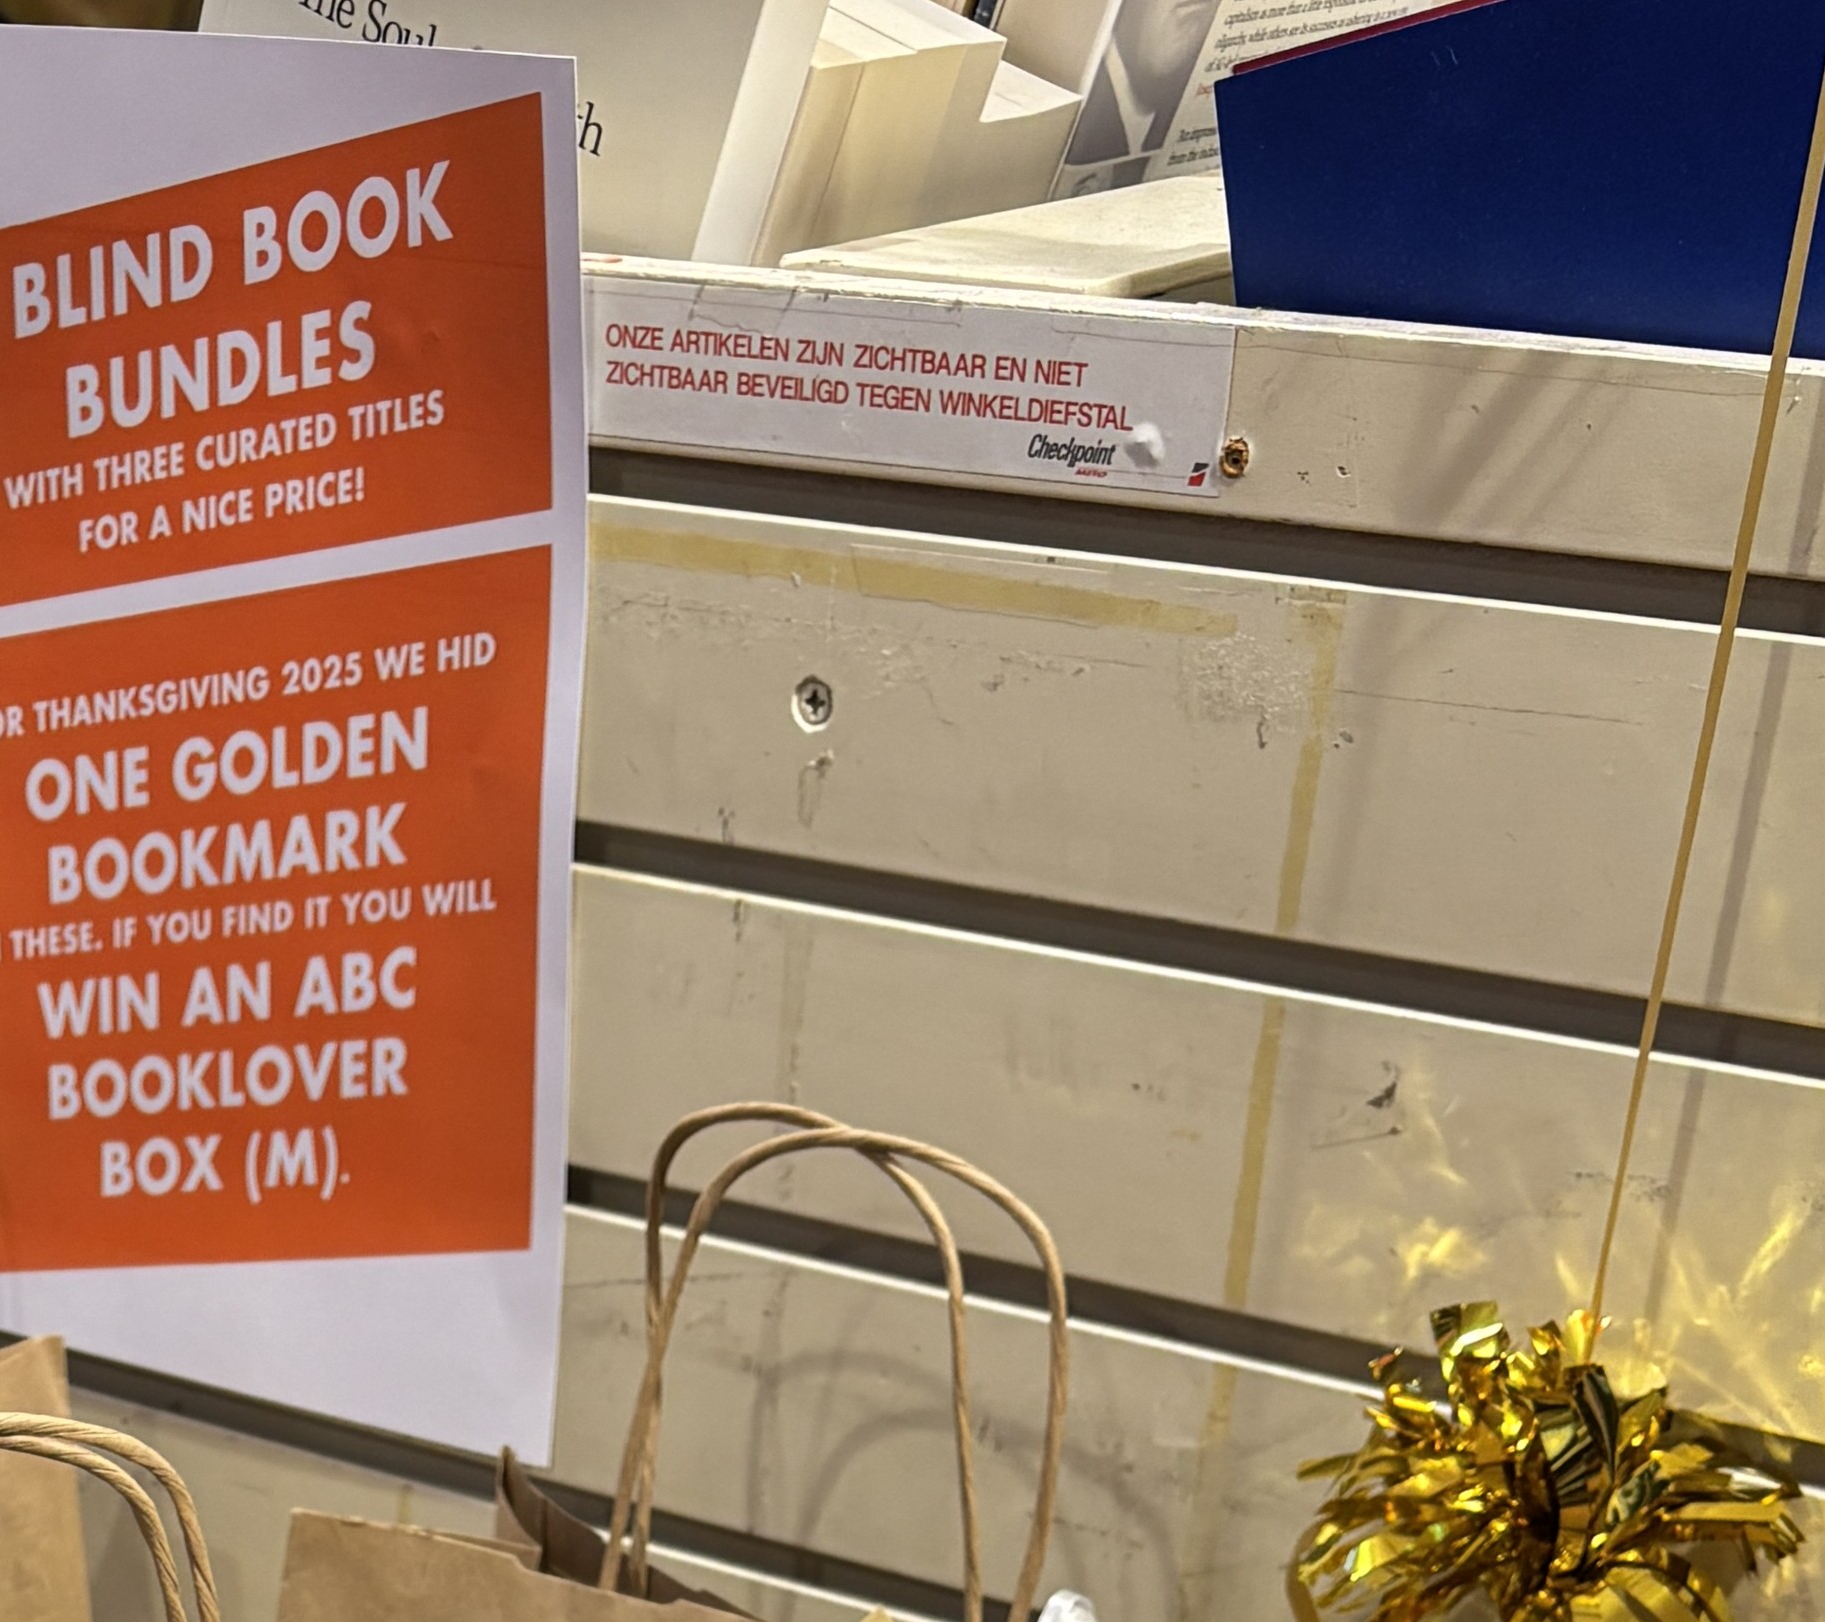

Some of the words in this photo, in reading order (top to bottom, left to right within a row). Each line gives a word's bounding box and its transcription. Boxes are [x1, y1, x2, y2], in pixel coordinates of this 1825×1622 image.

[14, 225, 212, 339] BLIND
[243, 160, 453, 285] BOOK
[66, 301, 376, 438] BUNDLES
[605, 323, 663, 351] ONZE
[670, 328, 790, 362] ARTIKELEN
[796, 339, 843, 367] ZIJN
[853, 343, 987, 379] ZICHTBAAR
[994, 355, 1027, 383] EN
[1034, 360, 1088, 388] NIET
[605, 360, 728, 394] ZICHTBAAR
[736, 371, 849, 404] BEVEILIGD
[856, 382, 932, 413] TEGEN
[939, 389, 1133, 431] WINKELDIEFSTAL
[4, 464, 84, 509] WITH
[93, 442, 184, 491] THREE
[196, 412, 337, 471] CURATED
[348, 390, 445, 441] TITLES
[1028, 434, 1116, 467] Checkpoint
[79, 512, 138, 553] FOR
[149, 504, 172, 540] A
[181, 489, 253, 534] NICE
[264, 466, 365, 518] PRICE!
[33, 666, 271, 732] THANKSGIVING
[281, 652, 363, 698] 2025
[375, 643, 426, 681] WE
[437, 632, 496, 671] HID
[25, 746, 150, 822] ONE
[173, 706, 429, 802] GOLDEN
[49, 802, 407, 905] BOOKMARK
[10, 920, 103, 962] THESE.
[113, 917, 138, 950] IF
[146, 908, 212, 947] YOU
[222, 900, 294, 940] FIND
[305, 896, 332, 928] IT
[342, 887, 412, 926] YOU
[423, 878, 496, 917] WILL
[38, 971, 160, 1040] WIN
[183, 960, 272, 1028] AN
[293, 947, 418, 1018] ABC
[49, 1037, 408, 1121] BOOKLOVER
[101, 1135, 223, 1198] BOX
[245, 1126, 350, 1204] (M).
